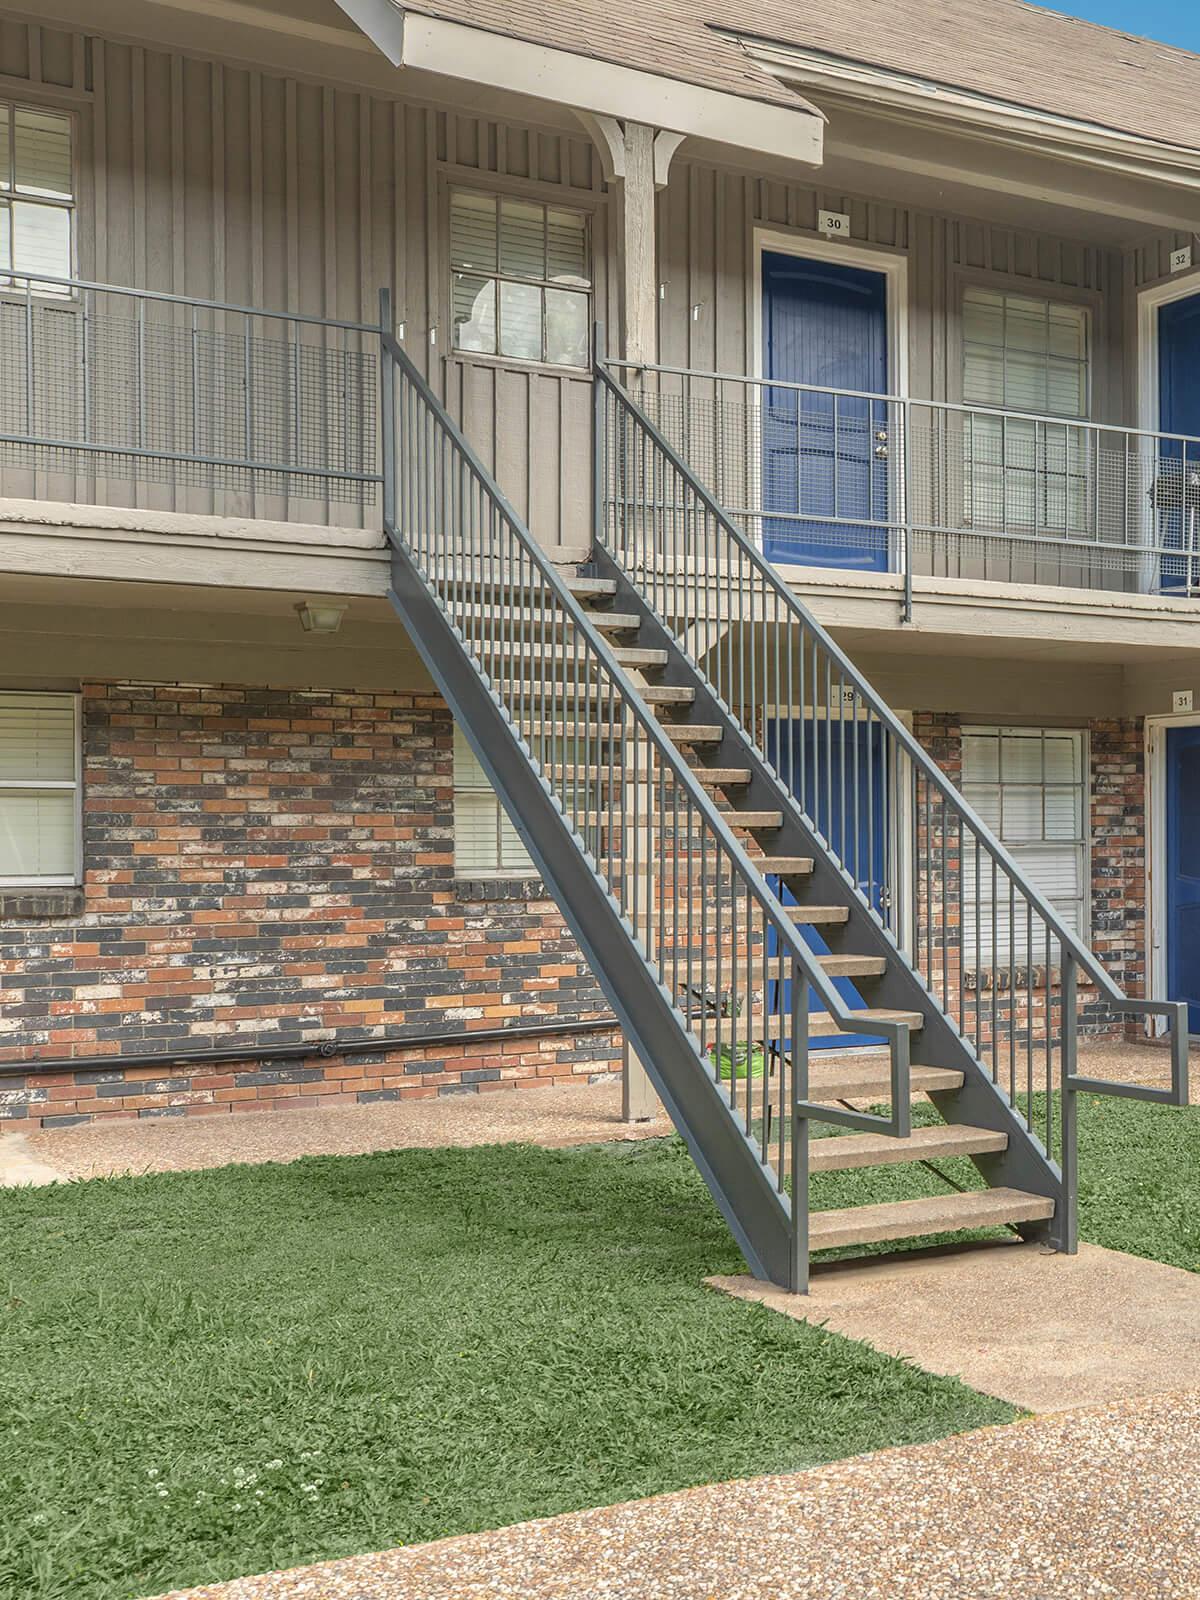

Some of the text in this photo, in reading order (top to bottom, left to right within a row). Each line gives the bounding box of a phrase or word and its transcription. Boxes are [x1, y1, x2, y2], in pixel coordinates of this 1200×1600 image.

[827, 217, 841, 229] 30
[1176, 254, 1185, 265] 32
[1178, 696, 1187, 706] 31
